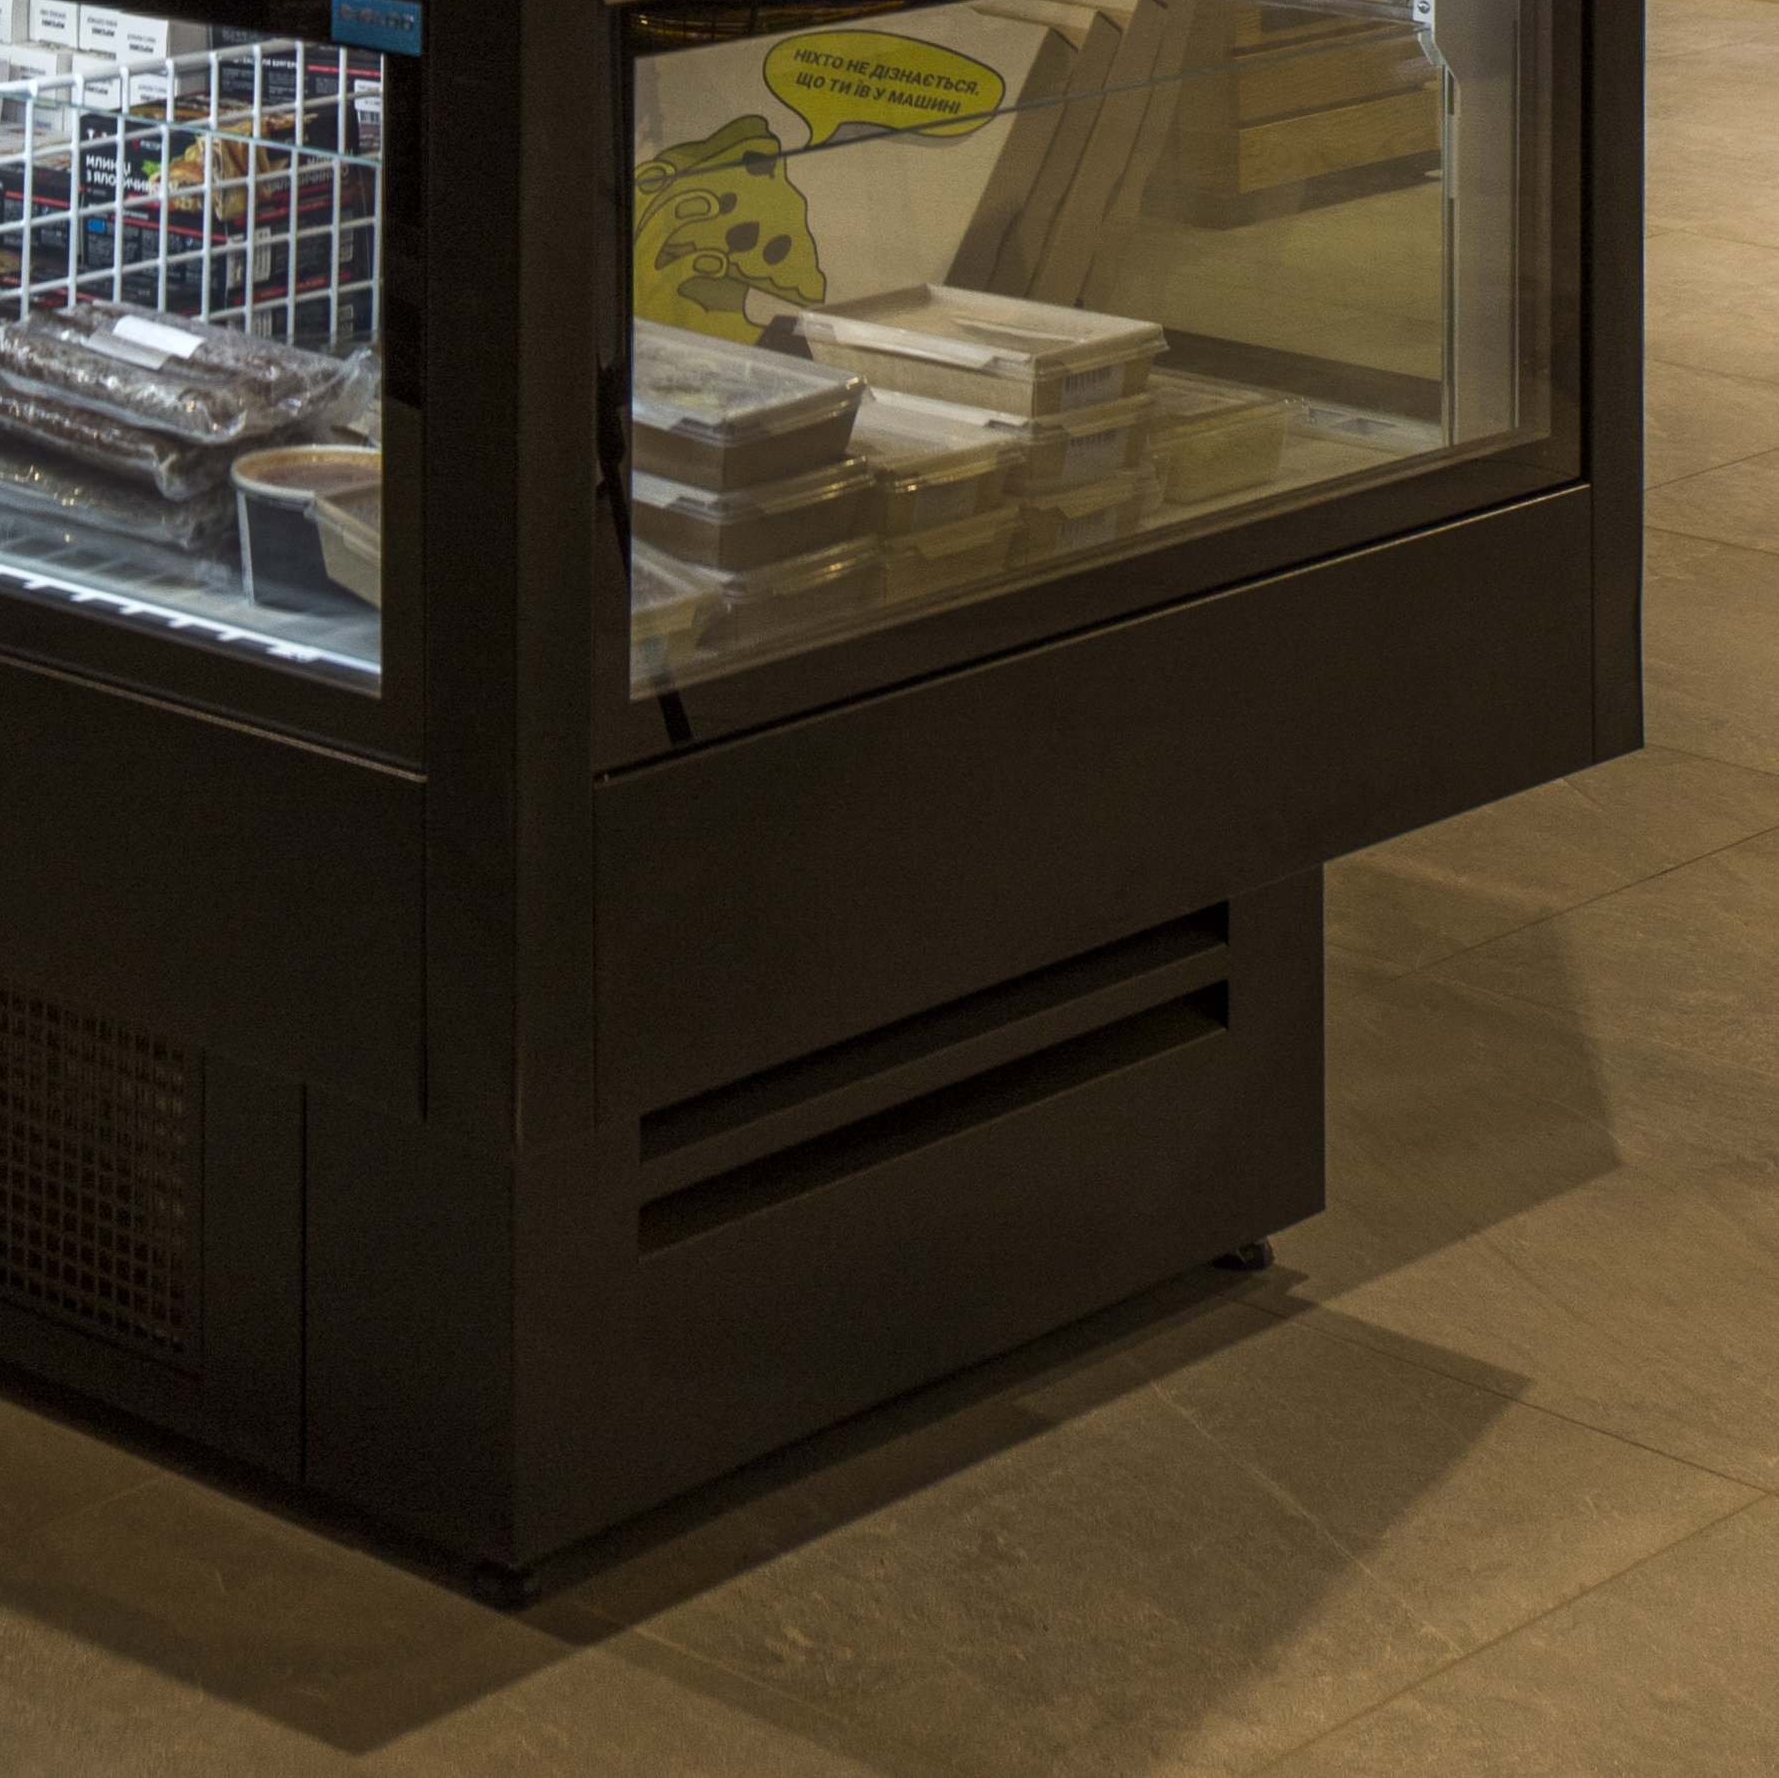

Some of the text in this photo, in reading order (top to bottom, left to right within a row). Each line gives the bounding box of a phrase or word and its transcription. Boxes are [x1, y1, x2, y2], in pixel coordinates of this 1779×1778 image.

[793, 48, 844, 71] НІХТО
[846, 59, 870, 76] НЕ
[795, 71, 962, 116] ЩО ТИ ЇВ У МАШИНІ
[85, 154, 132, 175] МЛИНІ
